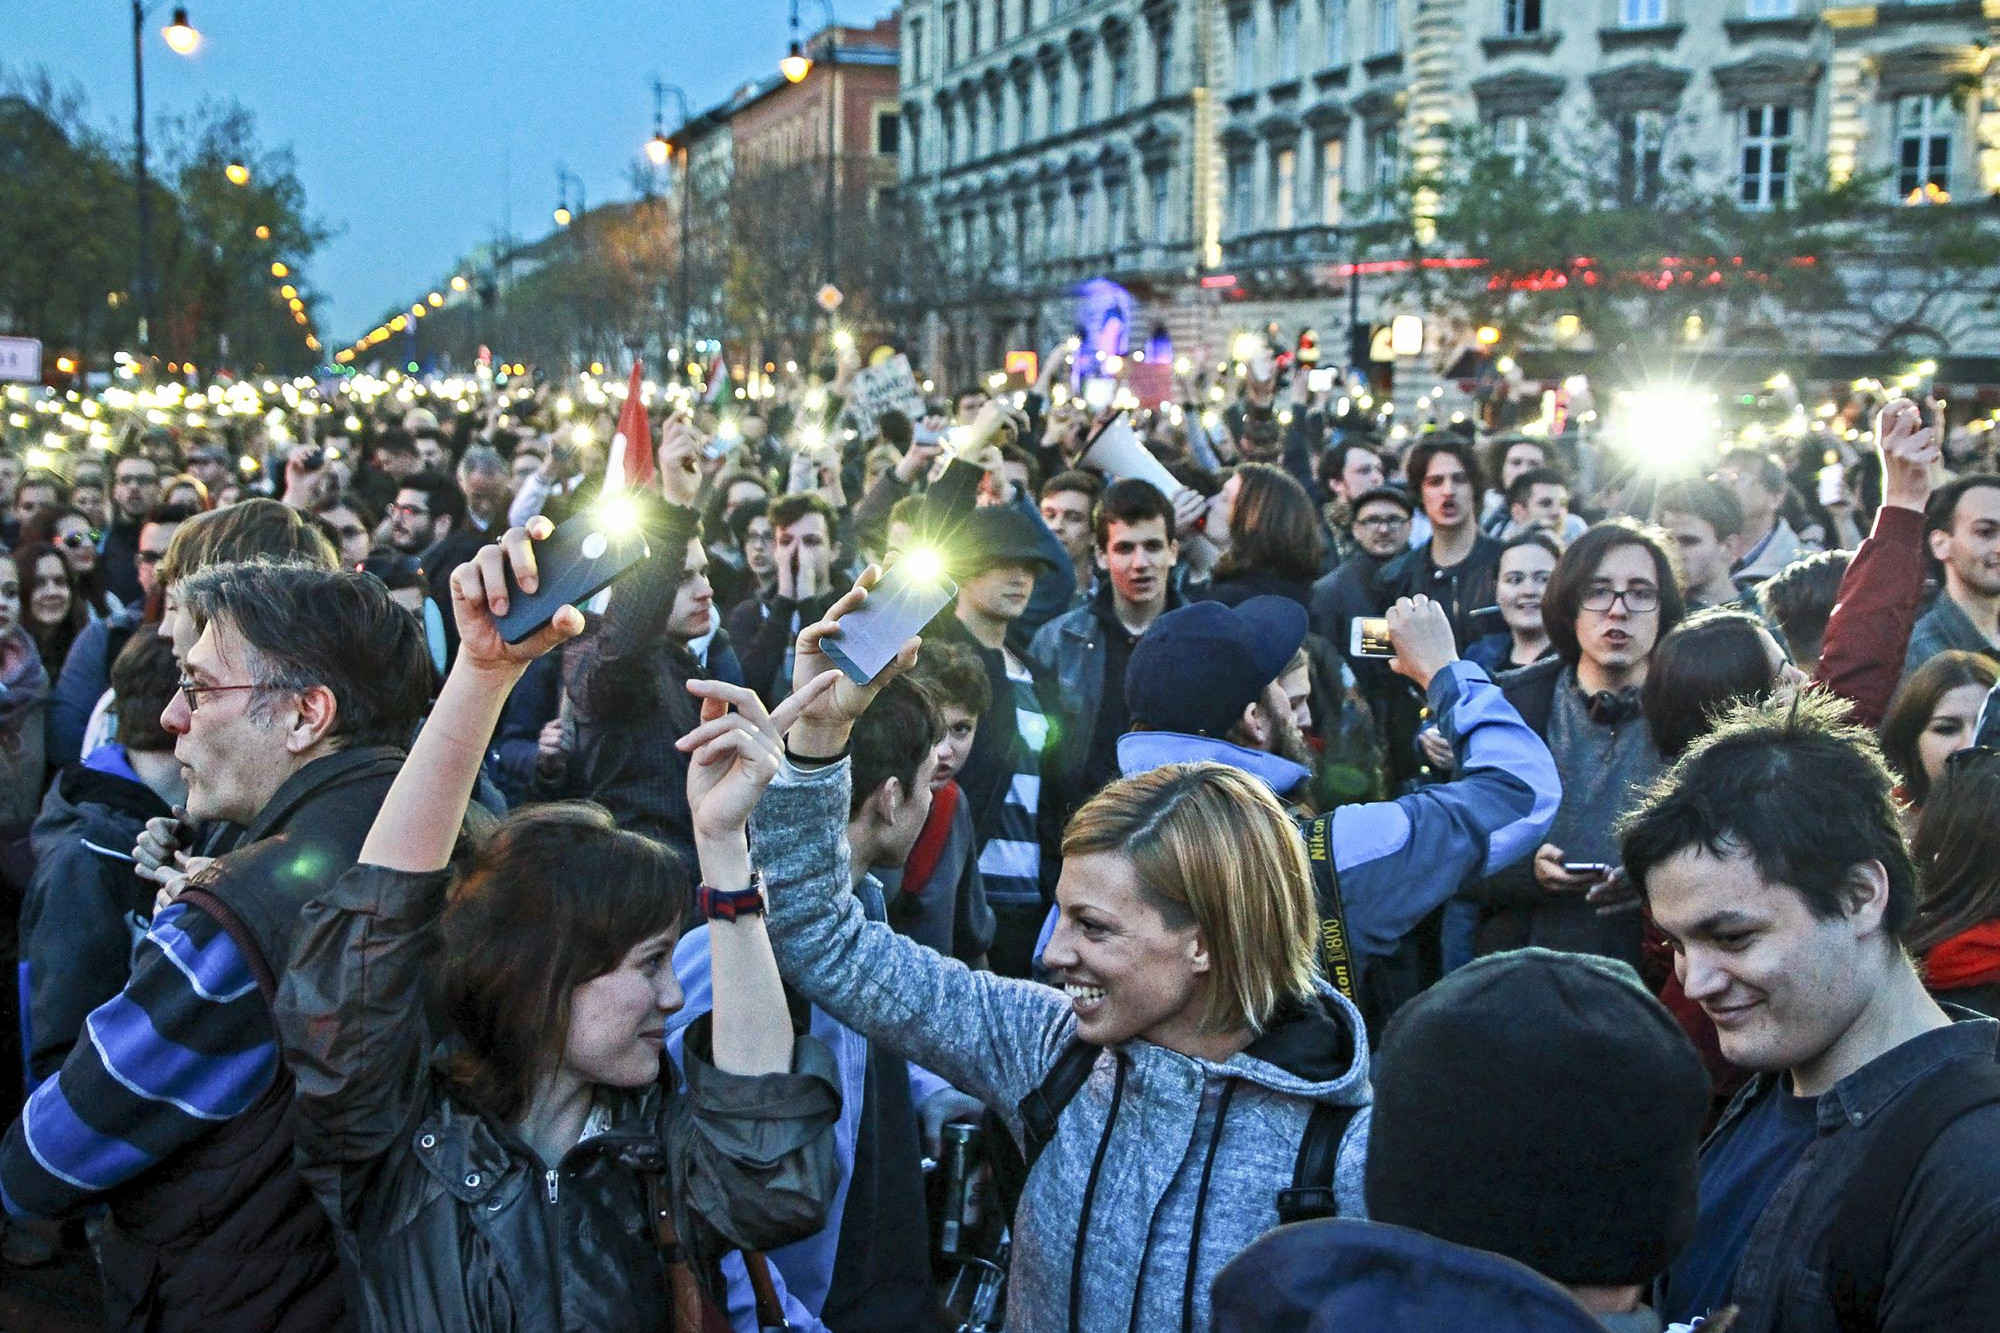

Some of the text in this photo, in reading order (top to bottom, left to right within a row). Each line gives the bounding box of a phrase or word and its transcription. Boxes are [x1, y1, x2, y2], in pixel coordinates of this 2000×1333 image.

[1309, 819, 1327, 861] Nikon
[1321, 919, 1352, 998] kon D800
